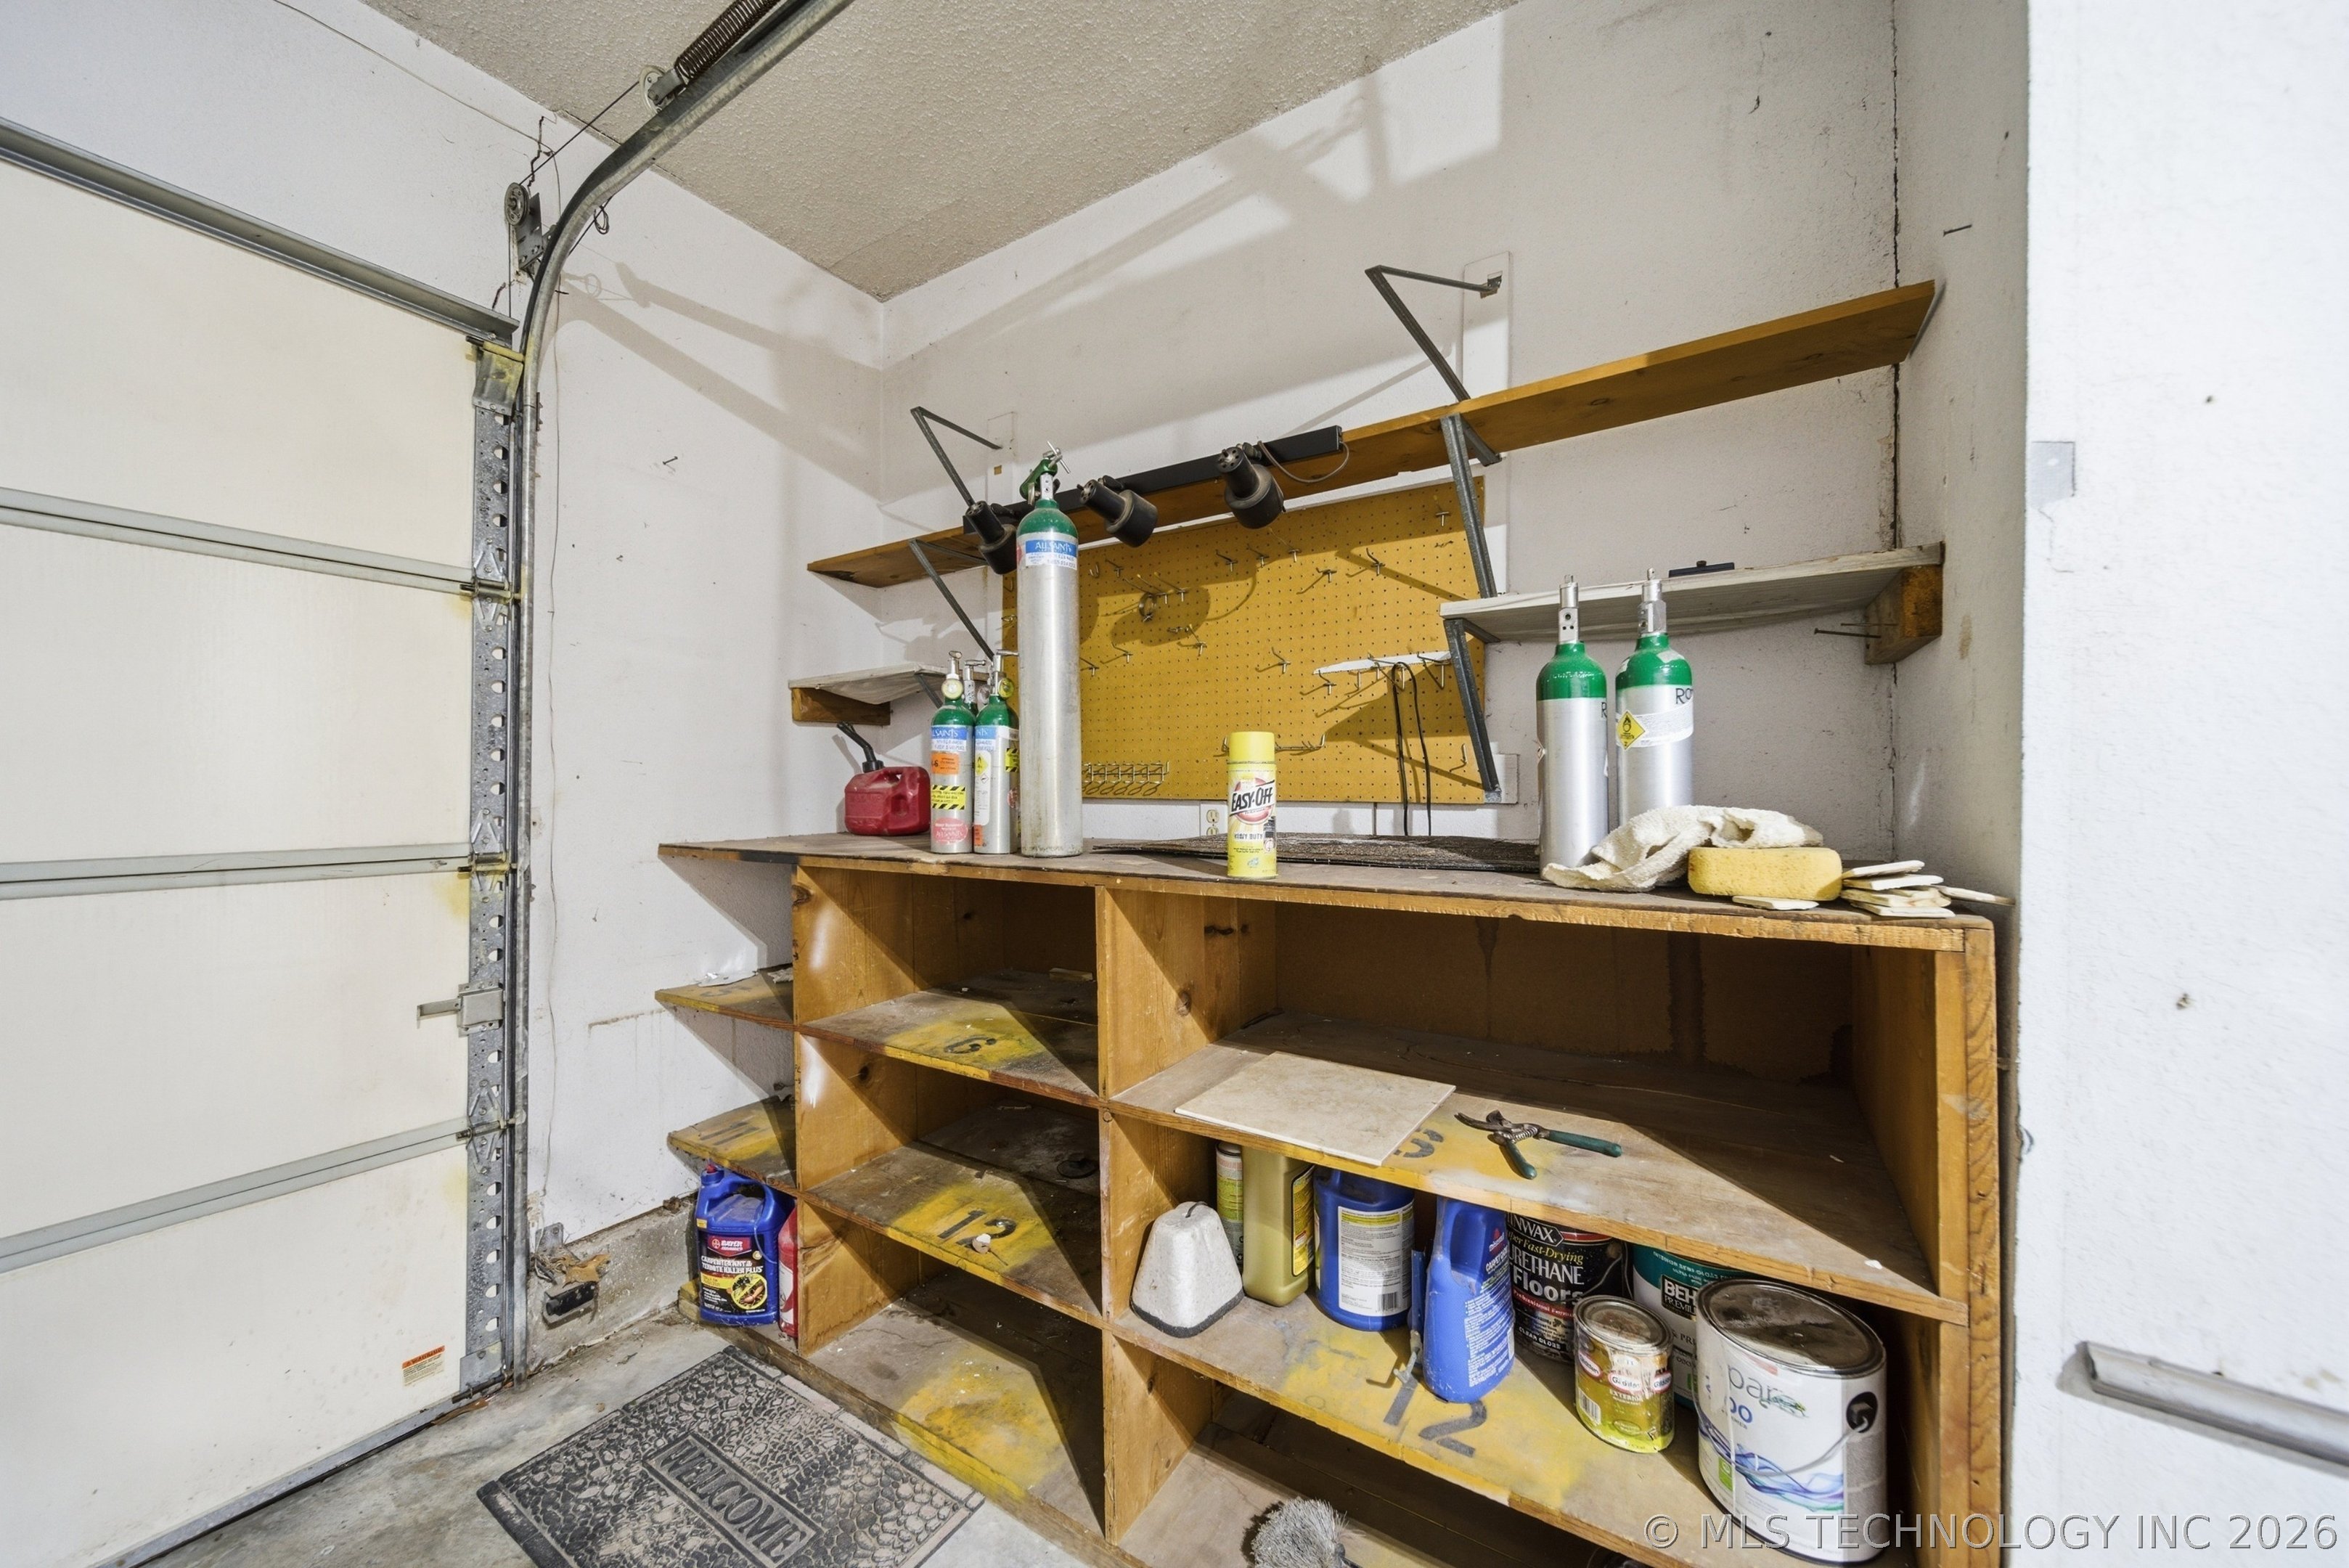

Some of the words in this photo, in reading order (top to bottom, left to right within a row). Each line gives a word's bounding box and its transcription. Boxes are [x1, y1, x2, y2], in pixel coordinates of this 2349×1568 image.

[1231, 787, 1273, 812] EASY-OFF
[1508, 1244, 1585, 1286] URETHANE
[1524, 1238, 1584, 1266] Fast-Drying
[1664, 1278, 1697, 1307] BEH
[1664, 1296, 1697, 1315] PREMIU
[660, 1440, 807, 1564] WELCOME
